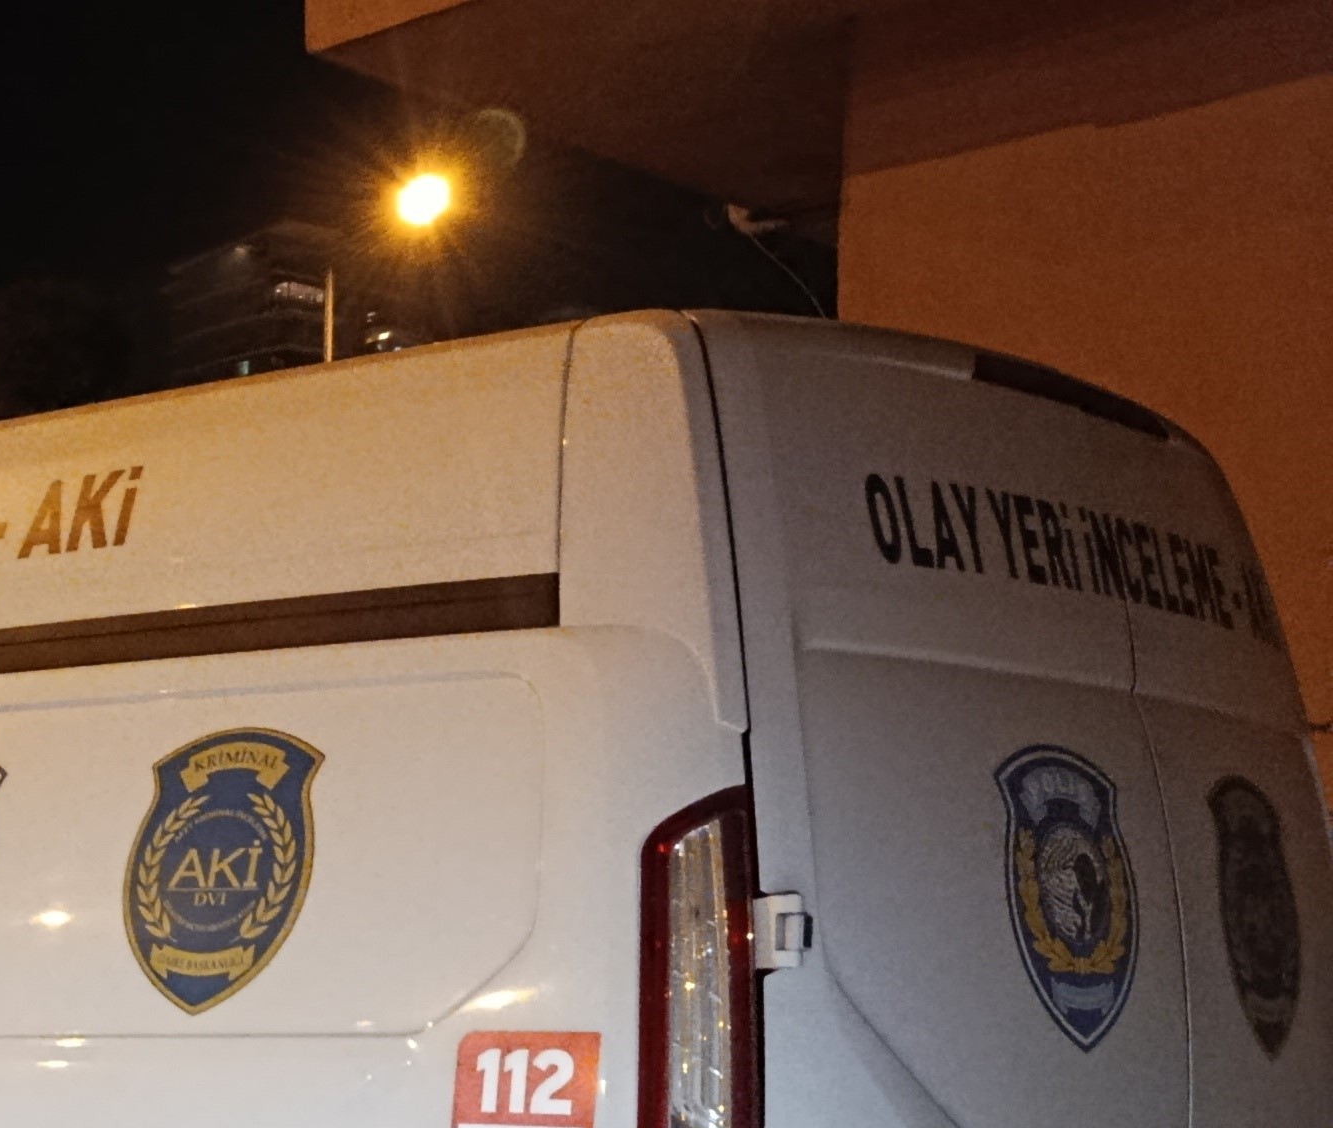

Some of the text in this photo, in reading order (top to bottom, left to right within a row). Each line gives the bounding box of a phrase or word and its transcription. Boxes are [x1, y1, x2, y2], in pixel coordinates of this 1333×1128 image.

[864, 473, 983, 574] OLAY
[167, 839, 263, 889] AKİ
[476, 1048, 575, 1115] 112
